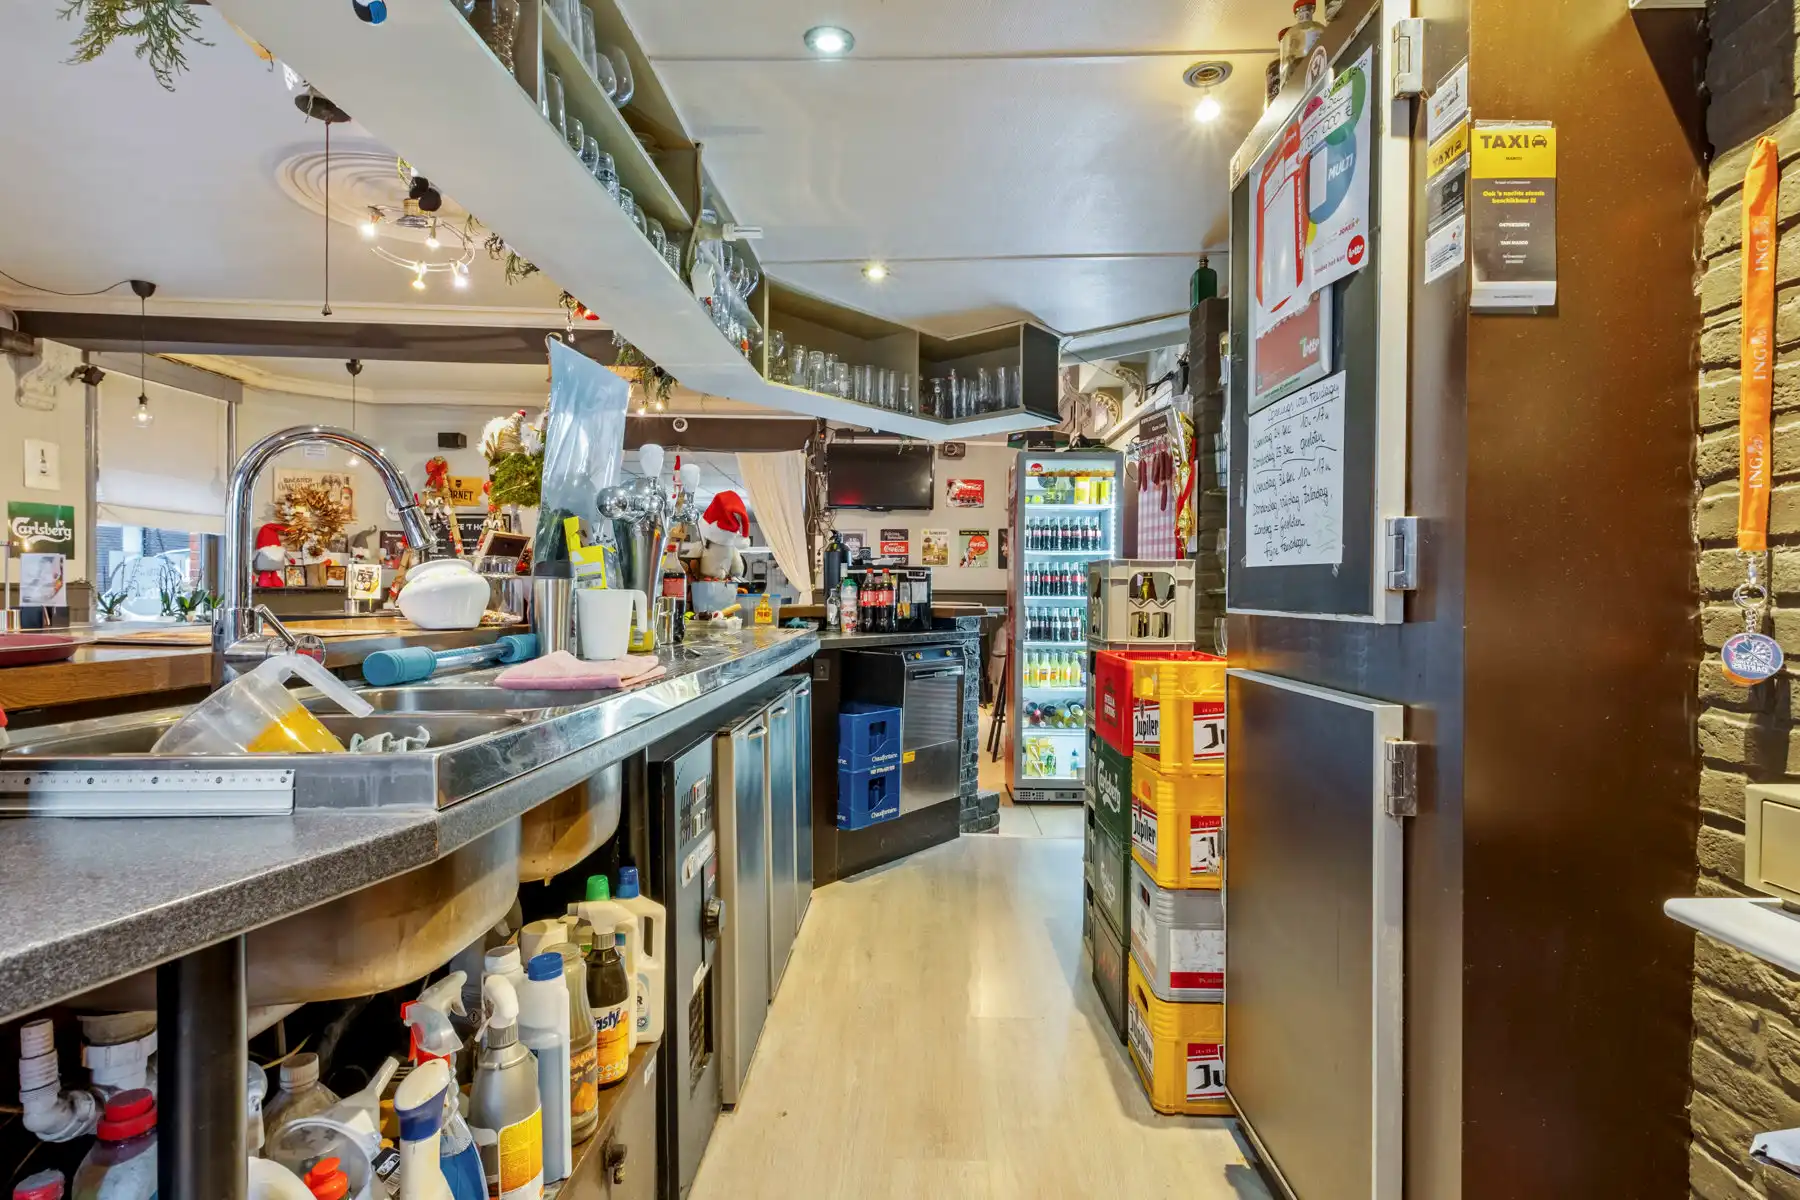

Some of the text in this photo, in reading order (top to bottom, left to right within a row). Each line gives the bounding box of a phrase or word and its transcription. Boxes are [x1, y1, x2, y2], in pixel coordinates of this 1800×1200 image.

[1480, 134, 1529, 149] TAXI
[1328, 153, 1354, 181] MULTI
[1754, 240, 1768, 272] ING
[1753, 347, 1767, 380] ING
[1749, 456, 1763, 489] ING
[12, 516, 73, 541] Carlsberg
[1134, 714, 1159, 741] Jupiler
[1133, 812, 1156, 845] Jupiler
[1130, 1010, 1153, 1065] Jupiler
